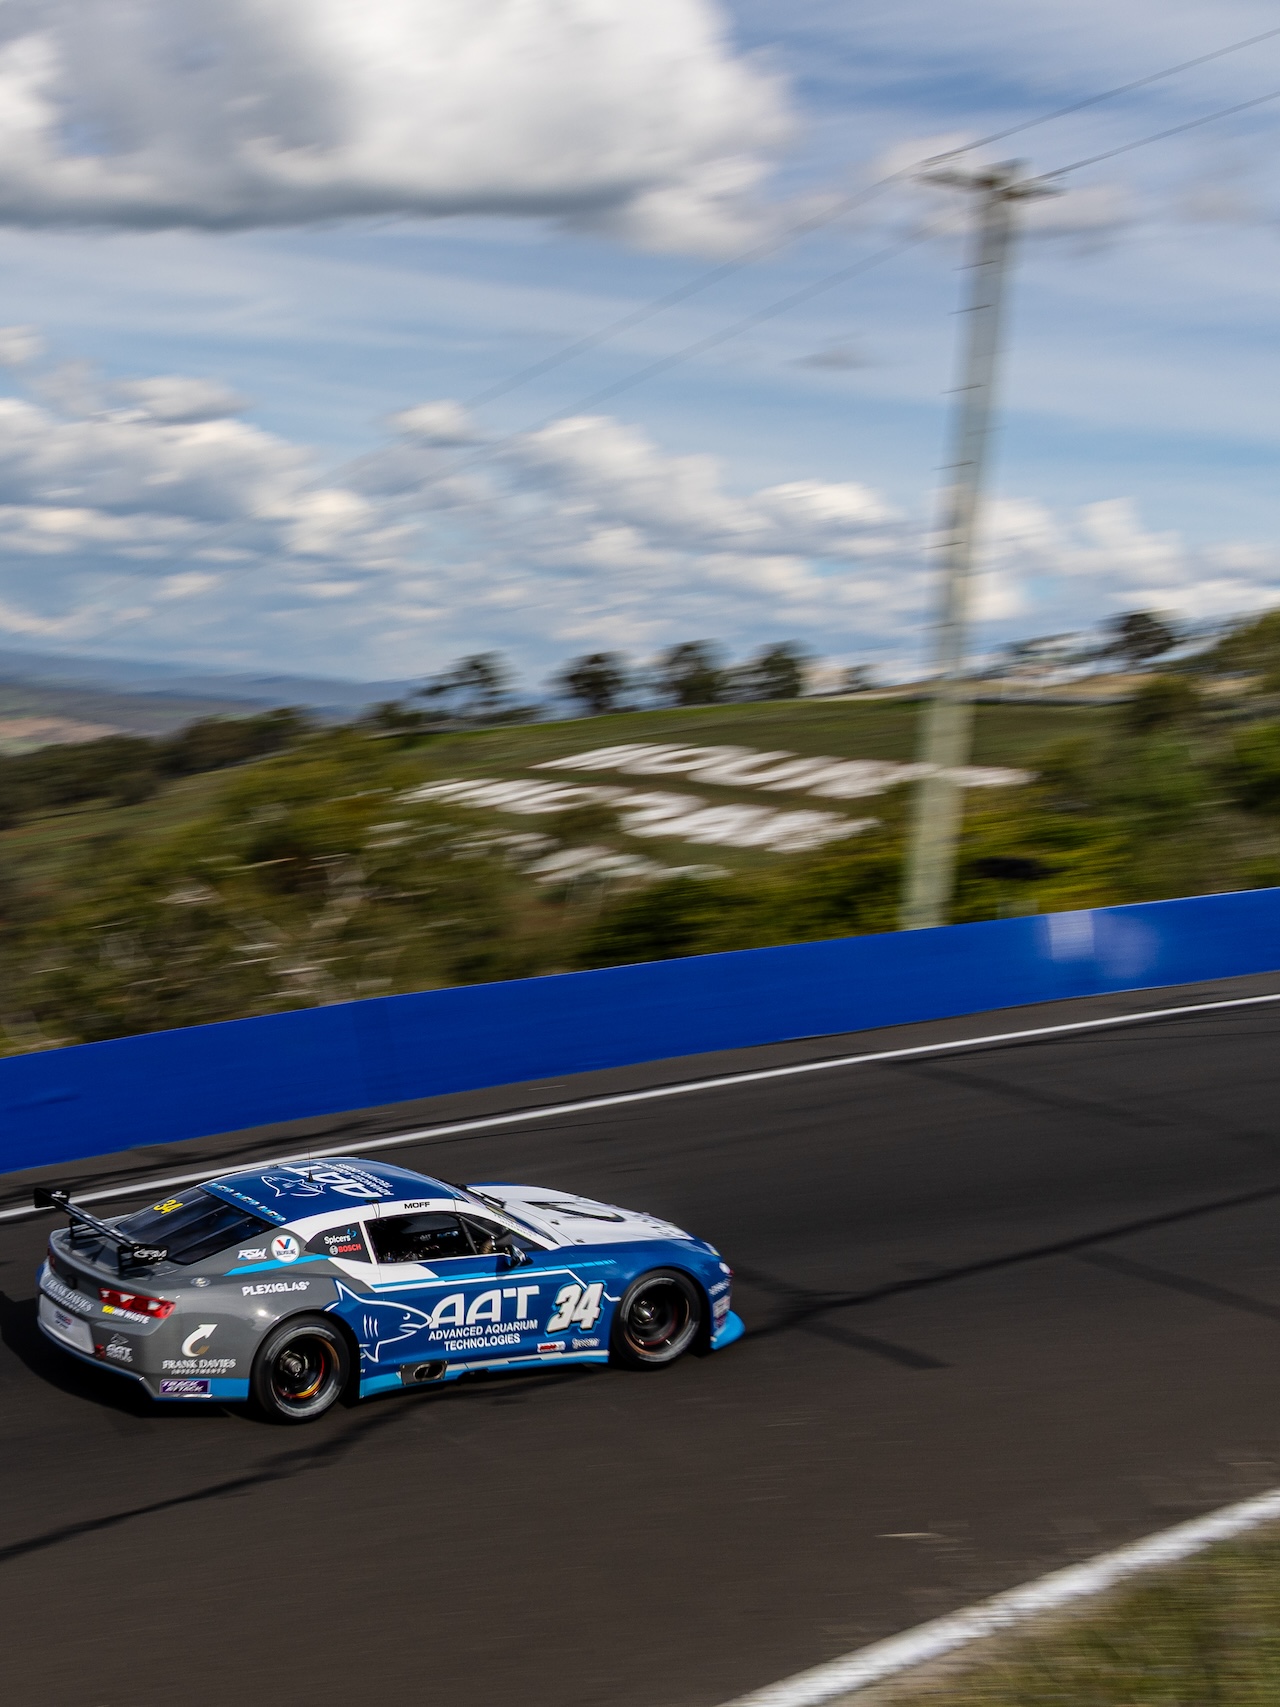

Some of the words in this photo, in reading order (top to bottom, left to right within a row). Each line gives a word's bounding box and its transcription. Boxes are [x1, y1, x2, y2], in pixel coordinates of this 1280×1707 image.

[153, 1199, 184, 1215] 34
[404, 1201, 431, 1210] MOFF
[324, 1234, 352, 1246] Spicers
[337, 1243, 362, 1253] BOSCH
[429, 1285, 540, 1329] AAT
[545, 1281, 607, 1336] 34
[428, 1326, 483, 1341] ADVANCED
[485, 1319, 538, 1335] AQUARIUM
[444, 1333, 521, 1351] TECHNOLOGIES
[162, 1359, 198, 1370] FRANK
[198, 1358, 237, 1369] DAVIES
